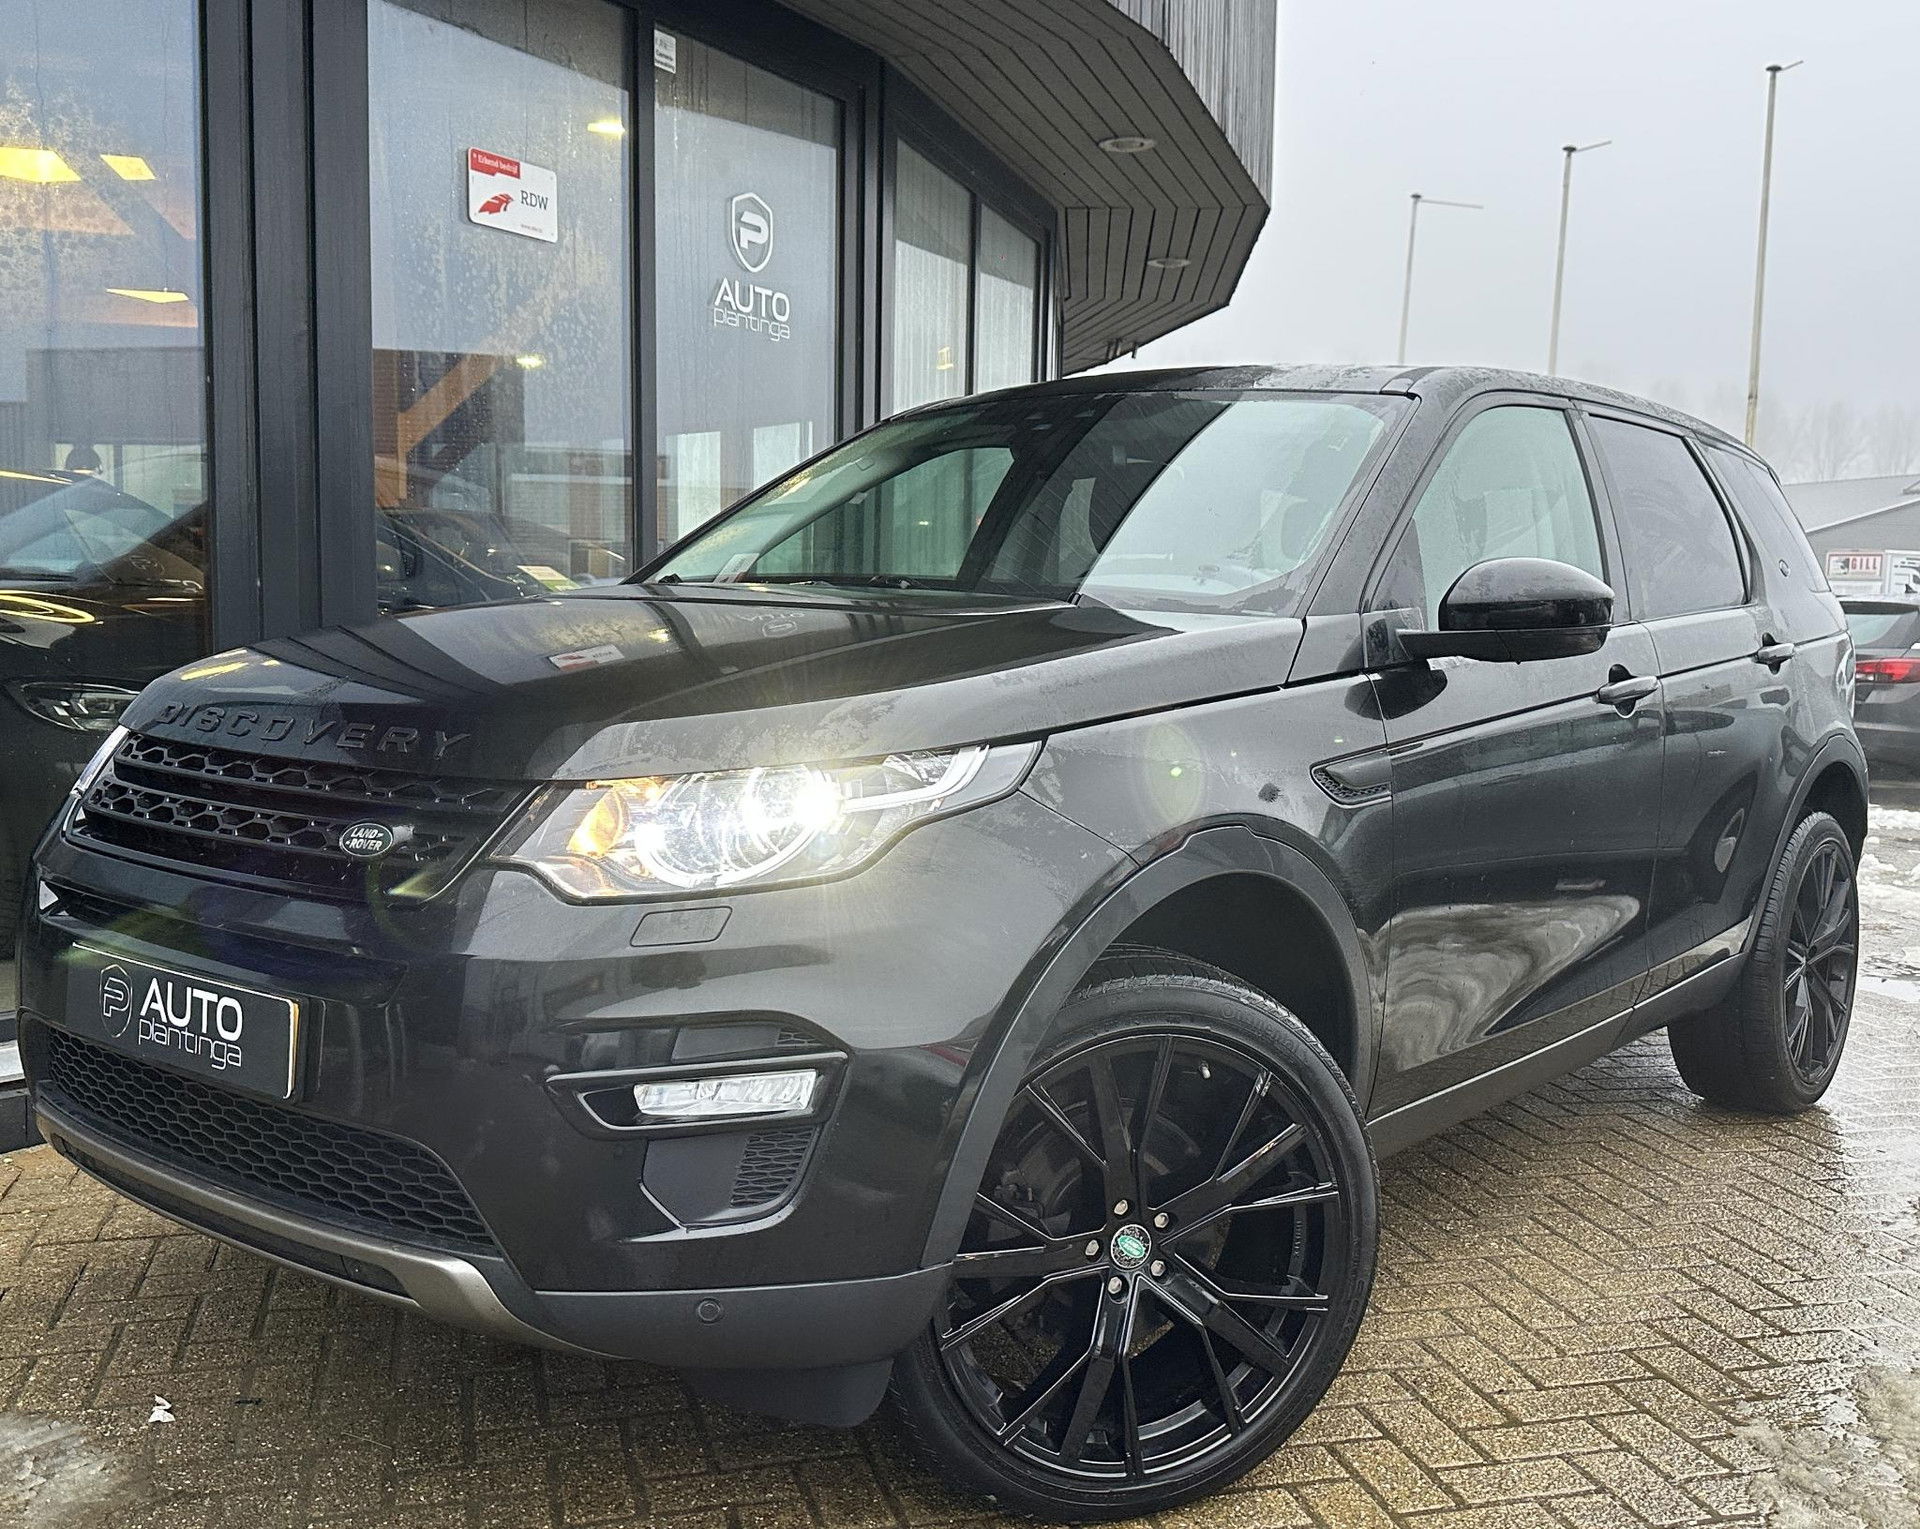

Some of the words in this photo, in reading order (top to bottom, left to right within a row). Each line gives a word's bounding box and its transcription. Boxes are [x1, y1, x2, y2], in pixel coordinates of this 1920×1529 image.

[520, 189, 549, 211] RDW
[714, 276, 791, 323] AUTO
[713, 306, 791, 342] plantinga
[1851, 557, 1877, 570] GILL
[156, 700, 471, 760] DISCOVERY
[139, 977, 243, 1042] AUTO
[138, 1017, 242, 1071] plantinga
